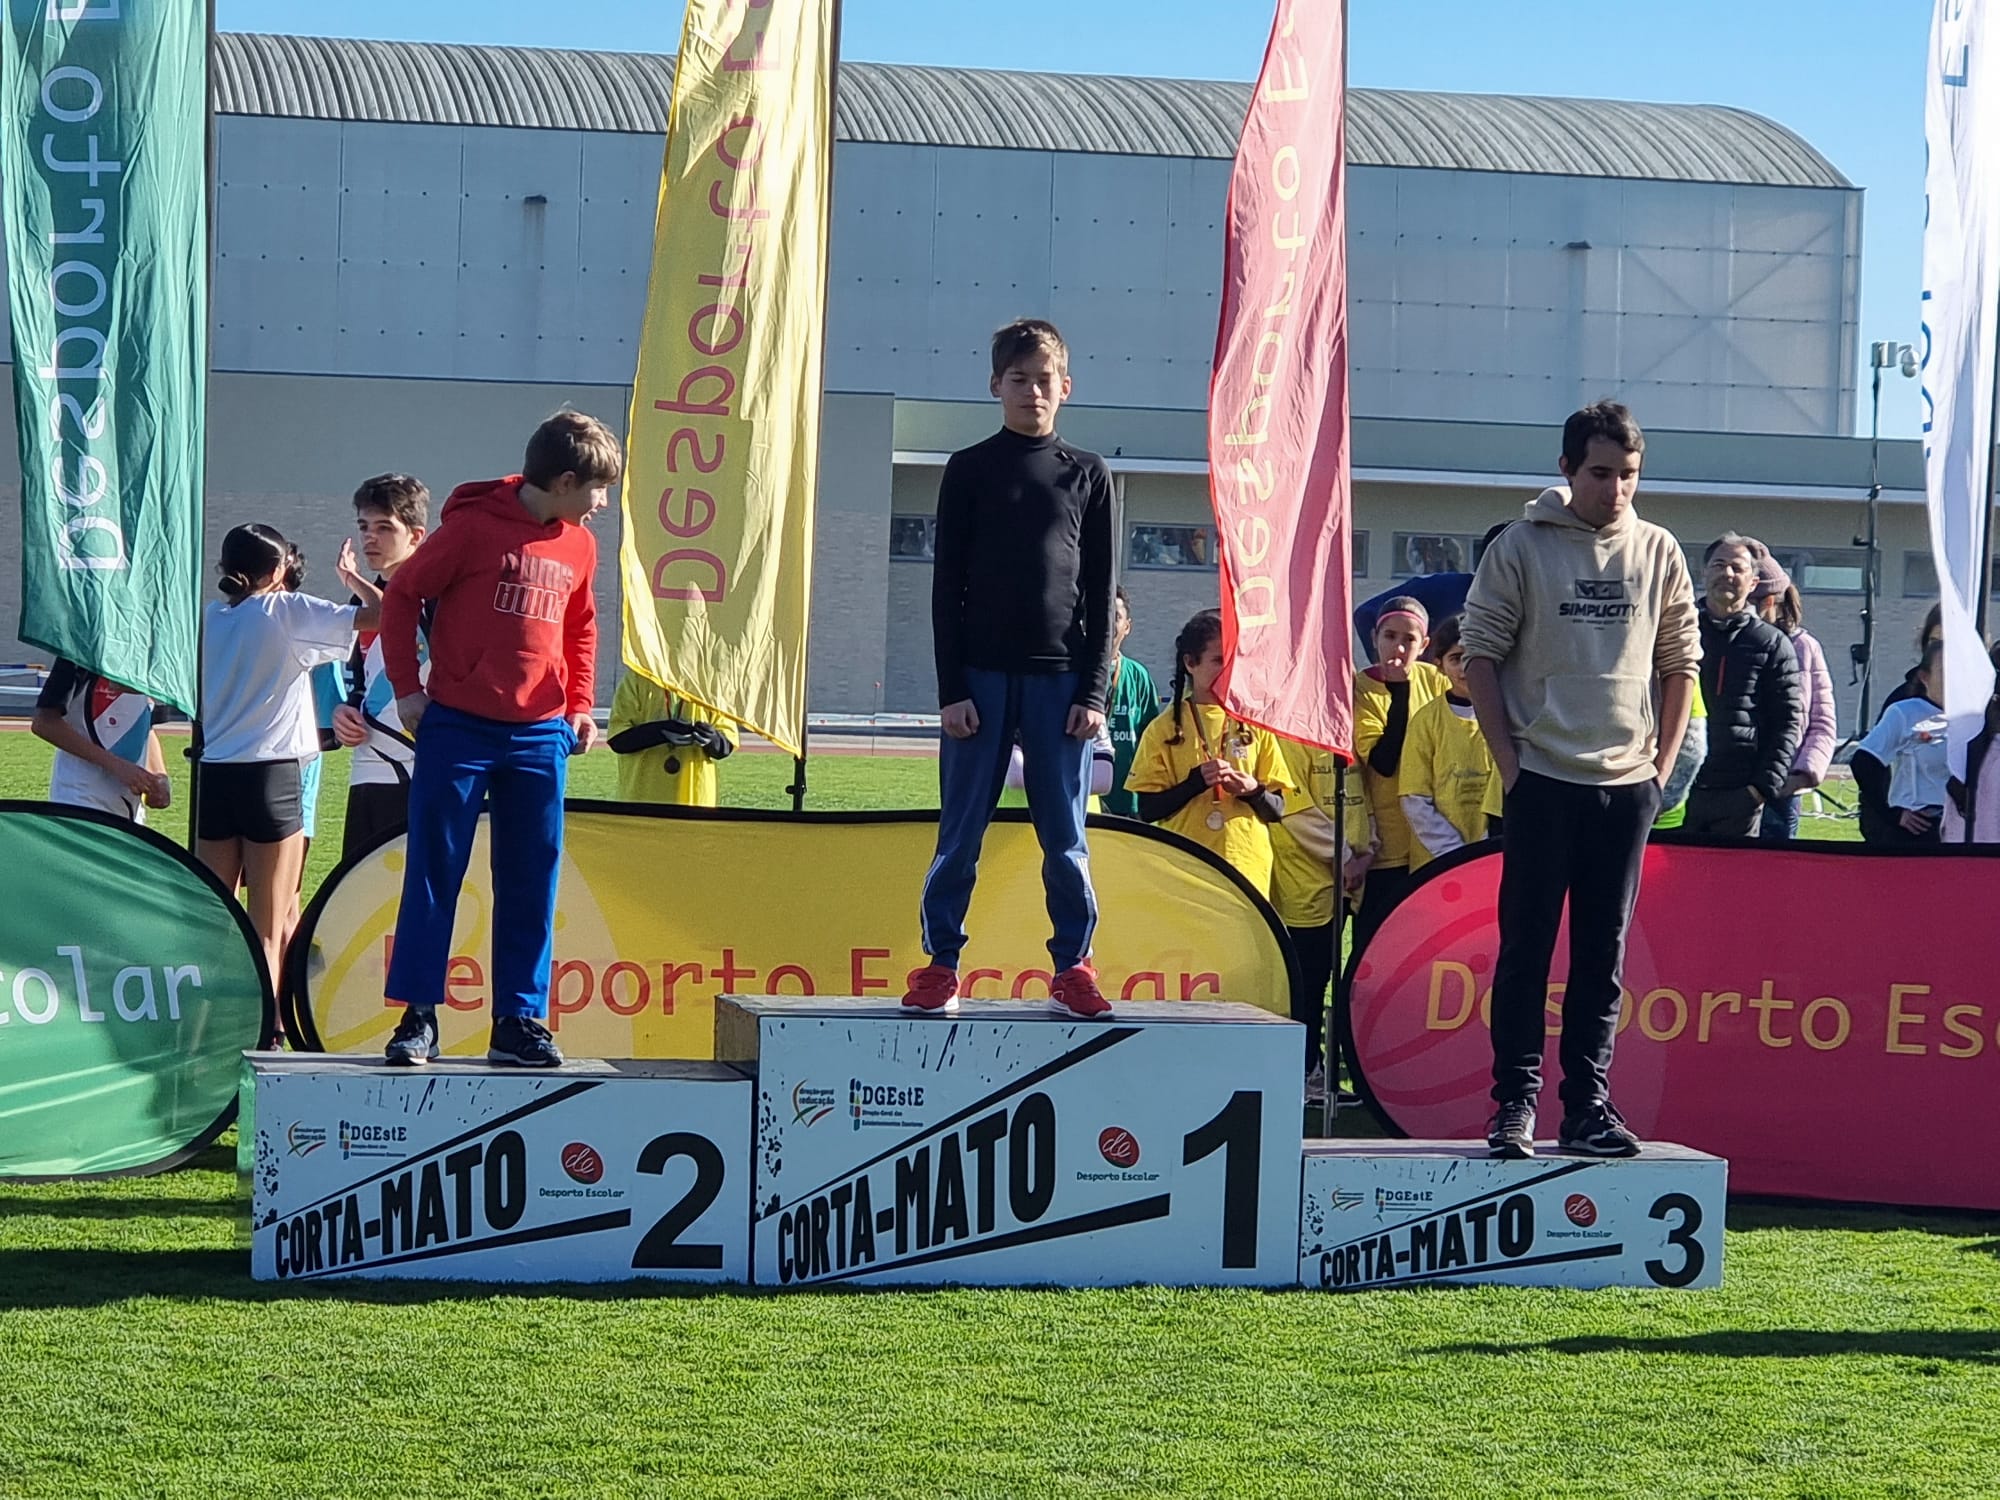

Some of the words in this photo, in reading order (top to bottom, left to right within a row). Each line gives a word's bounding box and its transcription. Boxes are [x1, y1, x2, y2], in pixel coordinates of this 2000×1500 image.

[1885, 983, 2000, 1059] Es
[862, 1086, 924, 1106] DGEstE
[275, 1130, 527, 1278] CORTA-MATO
[539, 1188, 584, 1198] Desporto
[585, 1188, 625, 1198] Escolar
[630, 1131, 726, 1270] 2
[777, 1092, 1056, 1284] CORTA-MATO
[1076, 1171, 1120, 1182] Desporto
[1121, 1172, 1160, 1181] Escolar
[1182, 1090, 1263, 1270] 1
[1320, 1193, 1535, 1288] CORTA-MATO
[1644, 1192, 1706, 1288] 3
